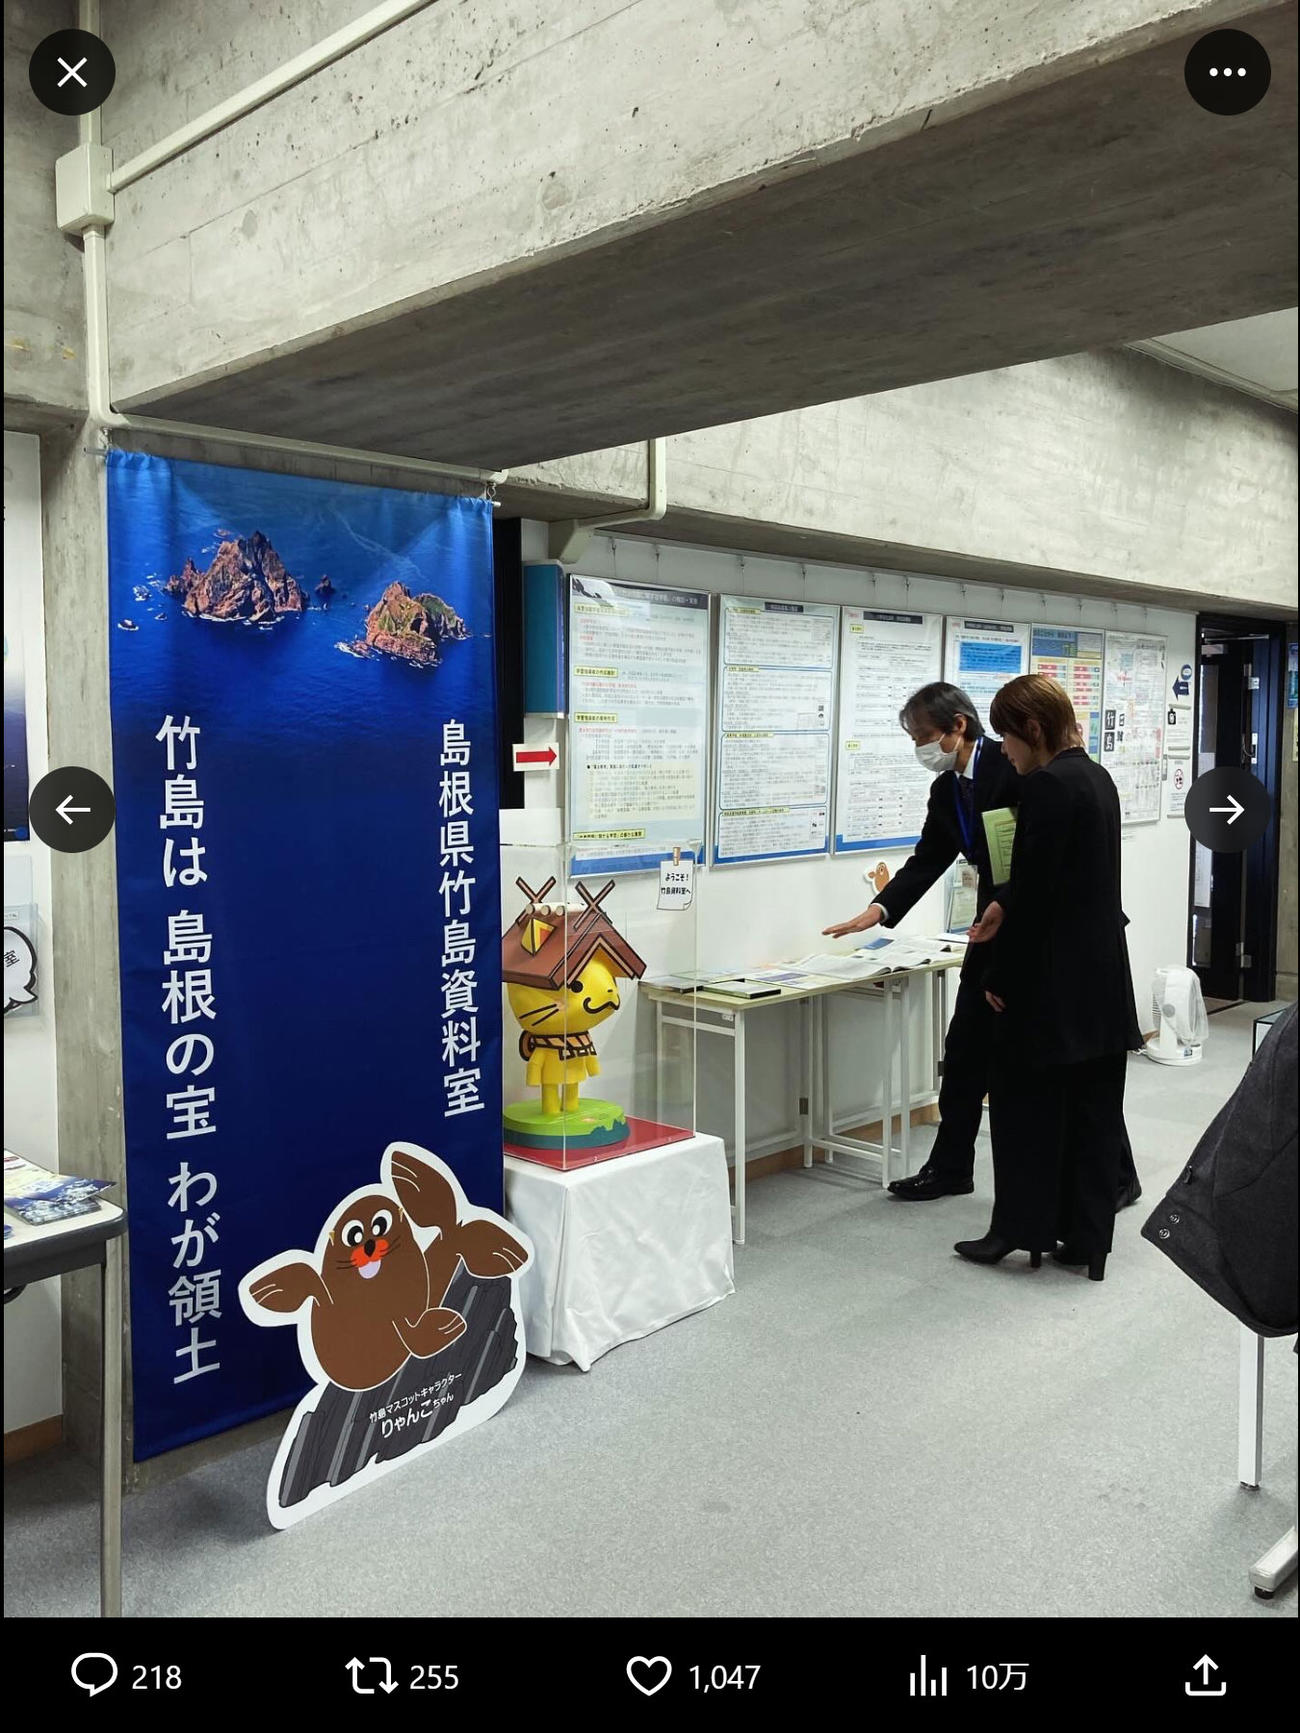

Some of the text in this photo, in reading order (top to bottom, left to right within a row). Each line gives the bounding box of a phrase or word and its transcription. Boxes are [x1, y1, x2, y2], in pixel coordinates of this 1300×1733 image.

[156, 715, 221, 1383] 竹島は 島根の宝 わが領土
[439, 719, 485, 1117] 島根県竹島資料室
[369, 1373, 462, 1423] 竹島マスコットキャラクター
